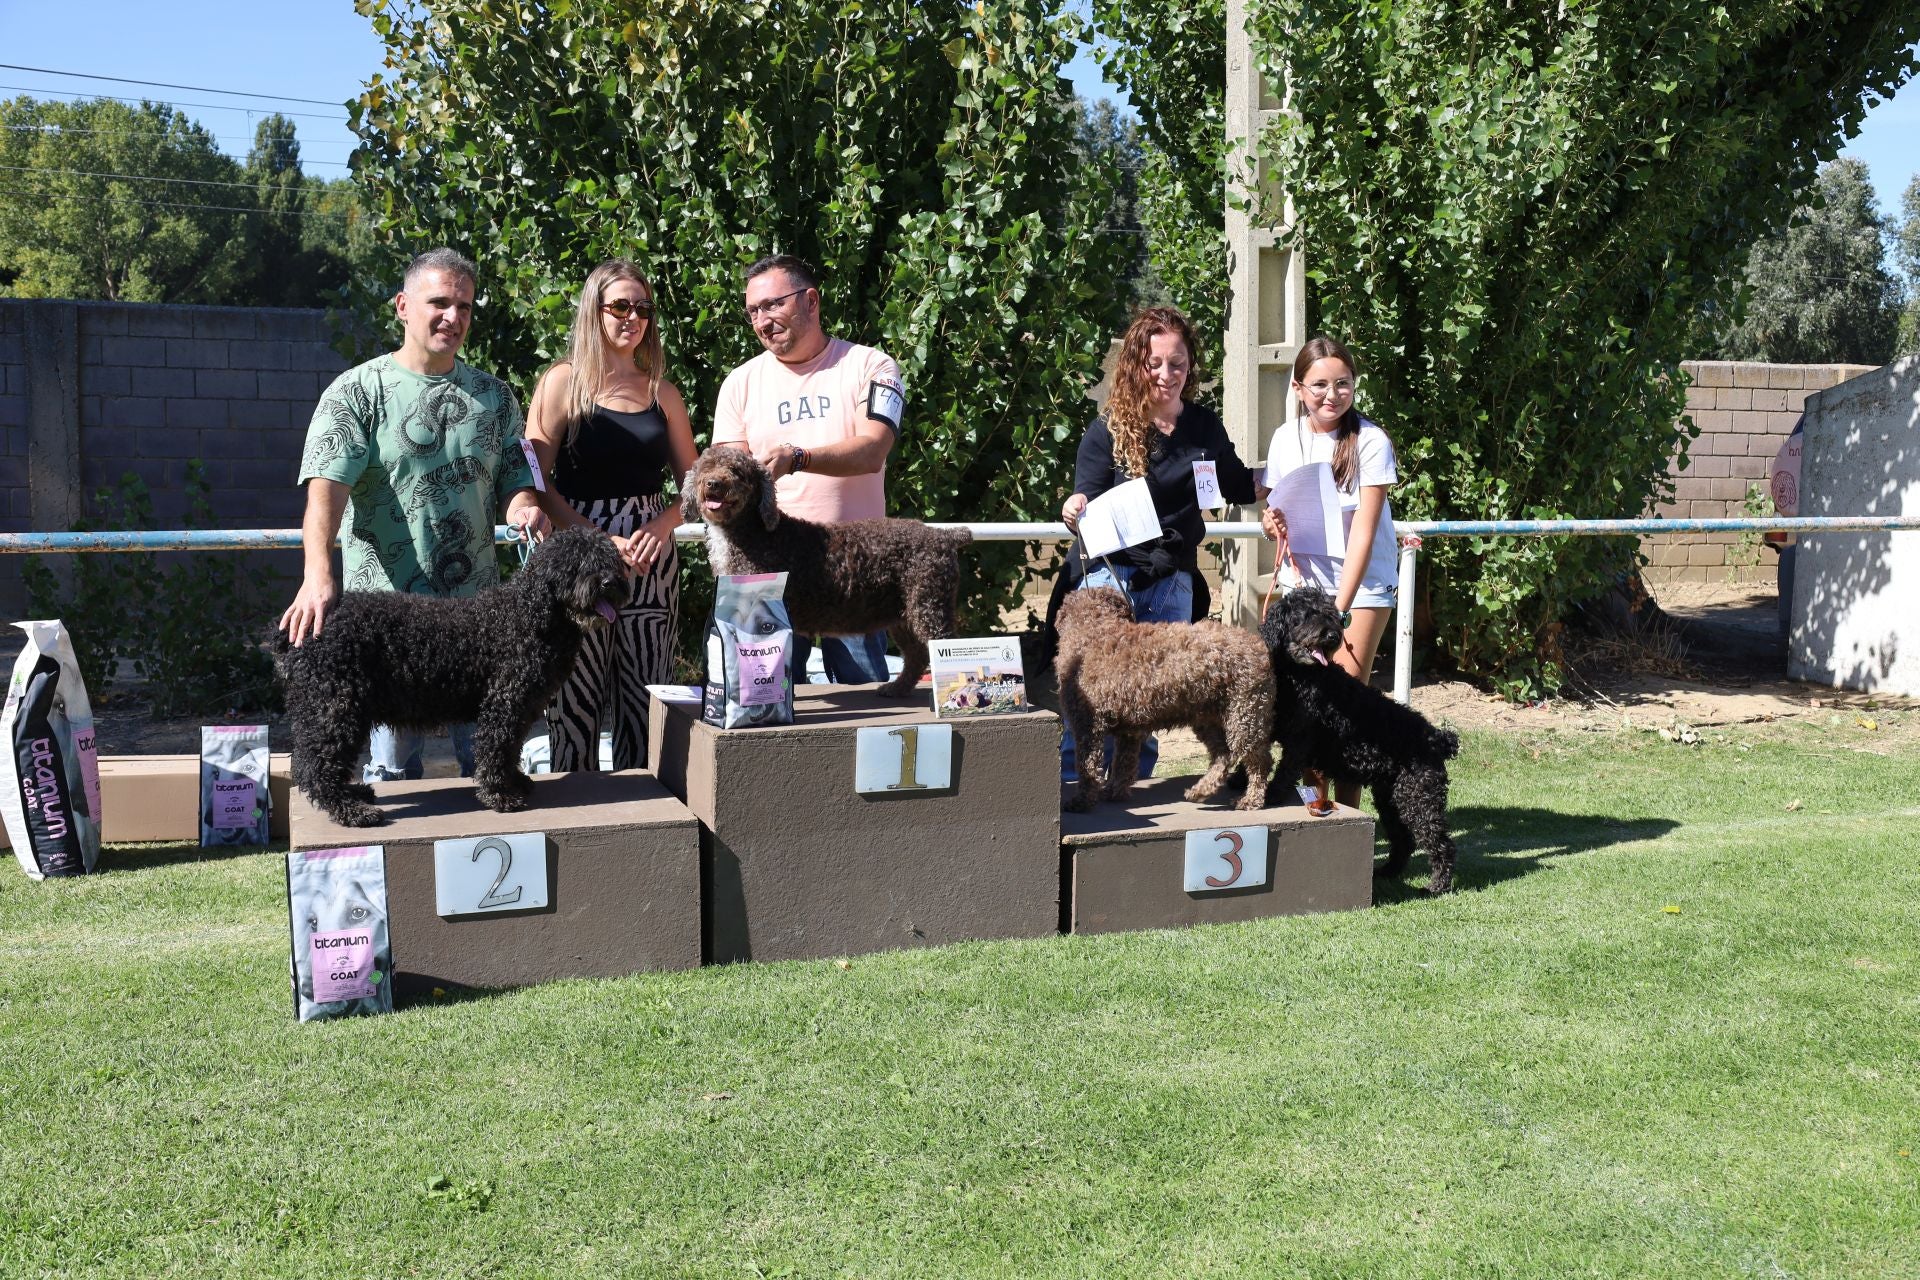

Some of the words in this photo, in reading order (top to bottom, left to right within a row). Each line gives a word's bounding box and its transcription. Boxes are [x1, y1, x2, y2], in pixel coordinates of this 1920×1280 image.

[778, 395, 831, 425] GAP
[1198, 479, 1214, 493] 45
[739, 645, 782, 657] titanium
[938, 648, 951, 657] VII
[754, 676, 776, 686] COAT
[992, 680, 1017, 689] CLASE
[887, 726, 928, 789] 1
[22, 777, 39, 809] COAT
[31, 737, 68, 840] titanium
[215, 782, 254, 792] titanium
[1205, 831, 1244, 888] 3
[471, 837, 523, 909] 2
[314, 936, 369, 950] titanium
[330, 971, 359, 981] COAT
